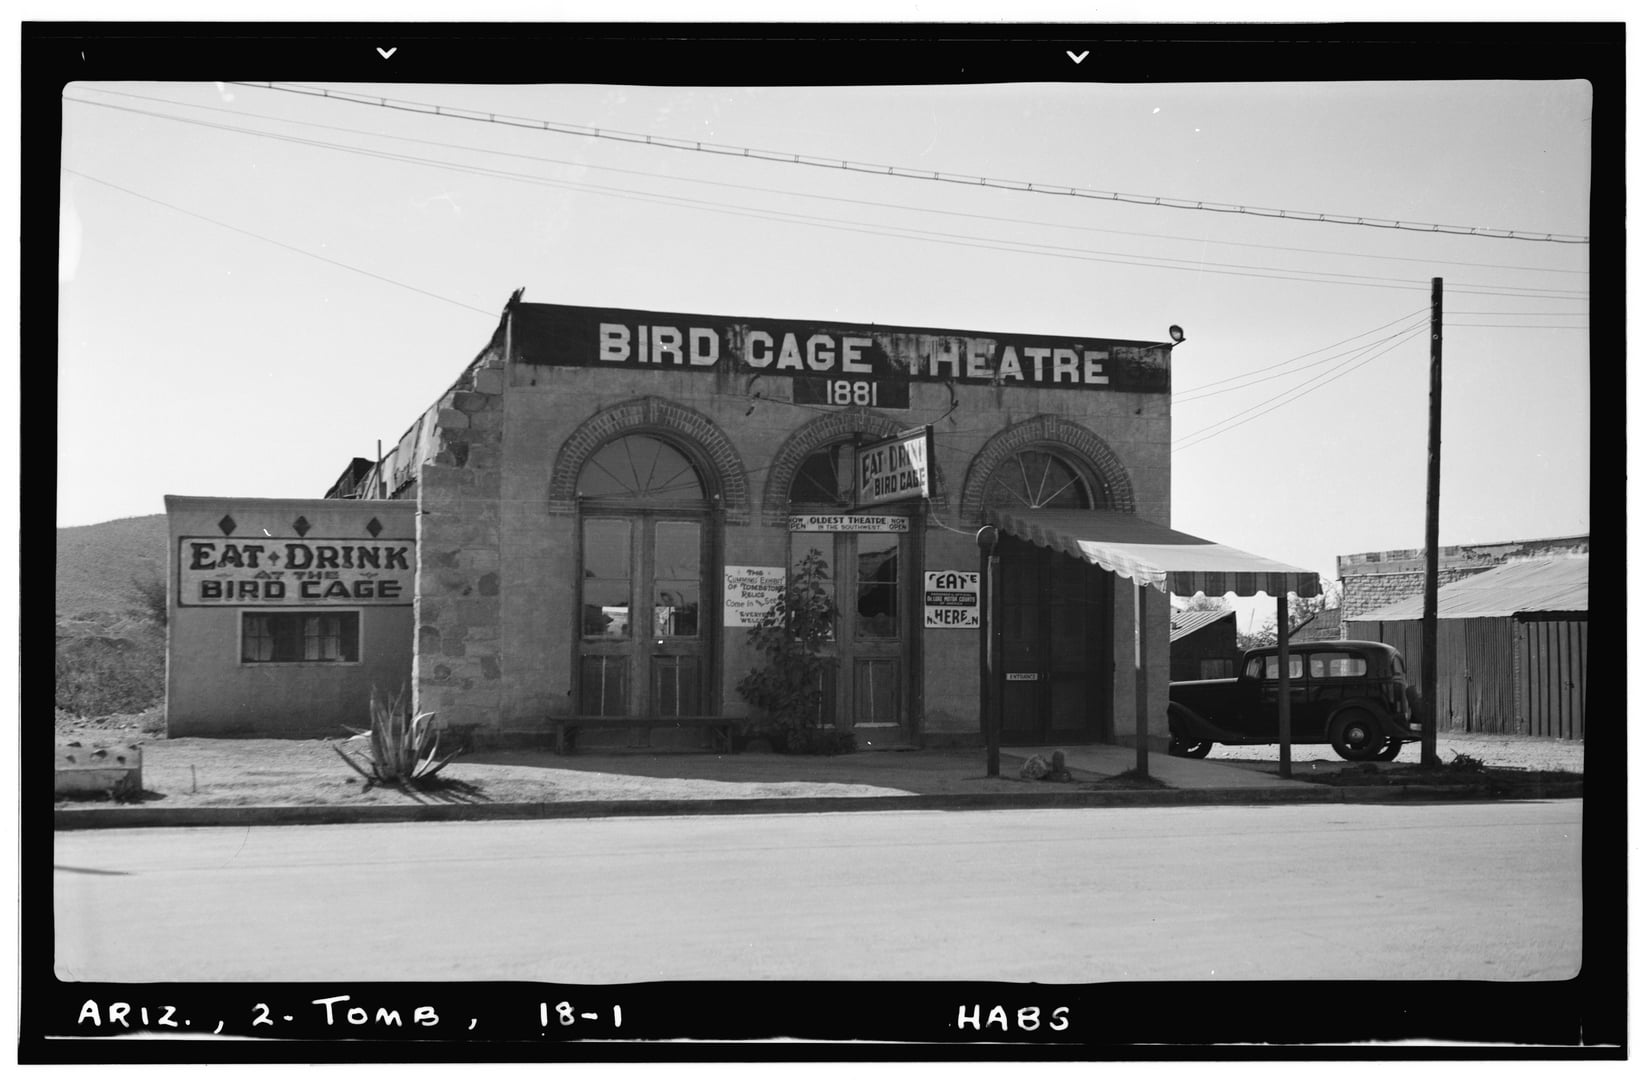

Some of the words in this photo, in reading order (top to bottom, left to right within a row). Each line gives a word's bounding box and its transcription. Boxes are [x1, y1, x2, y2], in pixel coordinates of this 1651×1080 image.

[600, 323, 719, 366] BIRD
[746, 331, 872, 373] CAGE
[902, 336, 1109, 384] THEATRE
[827, 380, 877, 406] 1881
[862, 451, 883, 488] EAT
[875, 474, 897, 496] BIRD
[848, 517, 886, 525] THEATRE
[190, 543, 264, 570] EAT
[284, 543, 409, 570] DRINK
[254, 570, 284, 579] AT
[293, 571, 339, 580] THE
[936, 573, 967, 589] EAT
[201, 580, 285, 598] BIRD
[301, 580, 402, 598] CAGE
[935, 609, 967, 625] HERE
